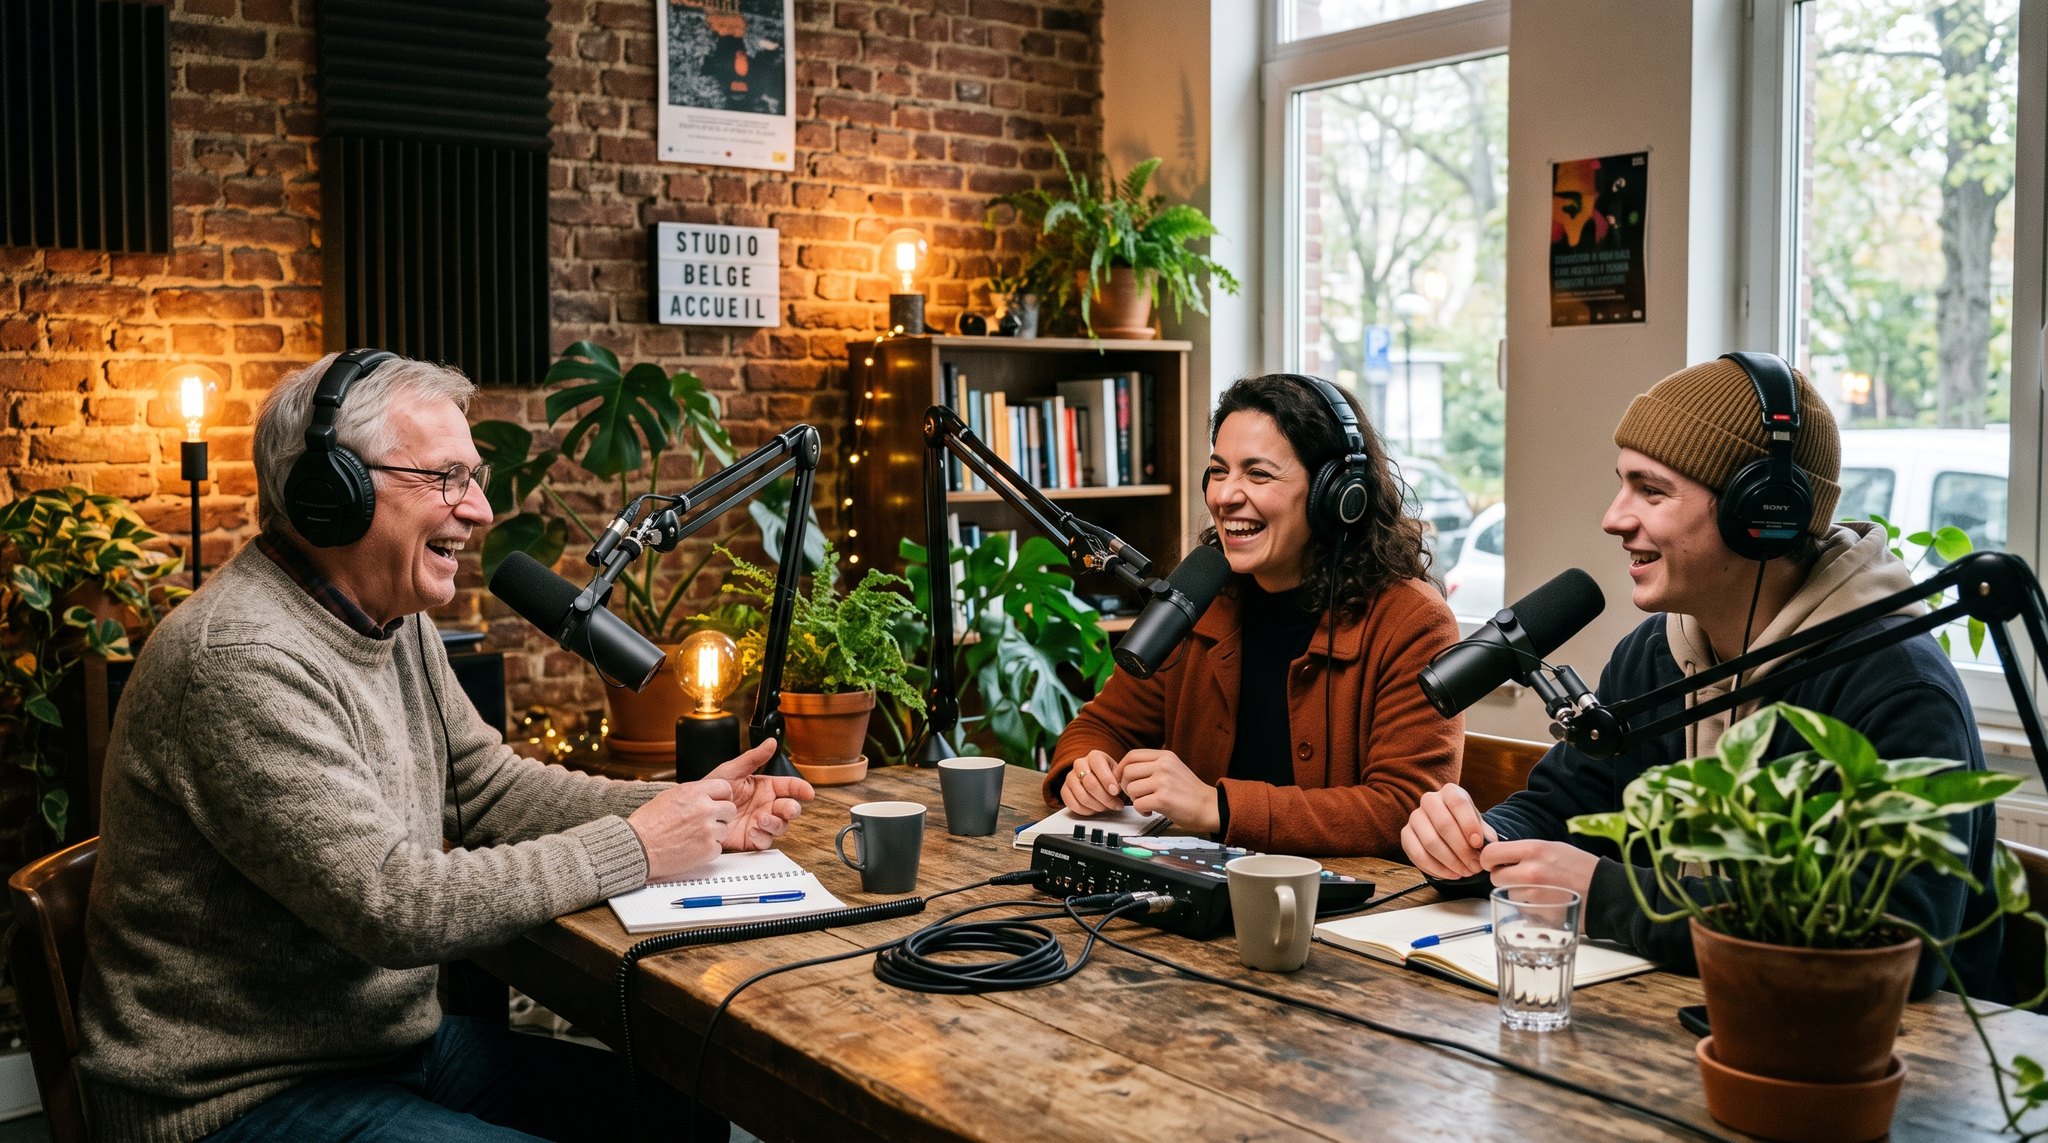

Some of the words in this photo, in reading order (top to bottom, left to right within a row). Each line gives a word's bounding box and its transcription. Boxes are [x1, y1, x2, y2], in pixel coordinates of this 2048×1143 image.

[677, 231, 758, 256] STUDIO
[684, 264, 751, 287] BELGE
[670, 295, 765, 319] ACCUEIL
[1370, 329, 1387, 357] P
